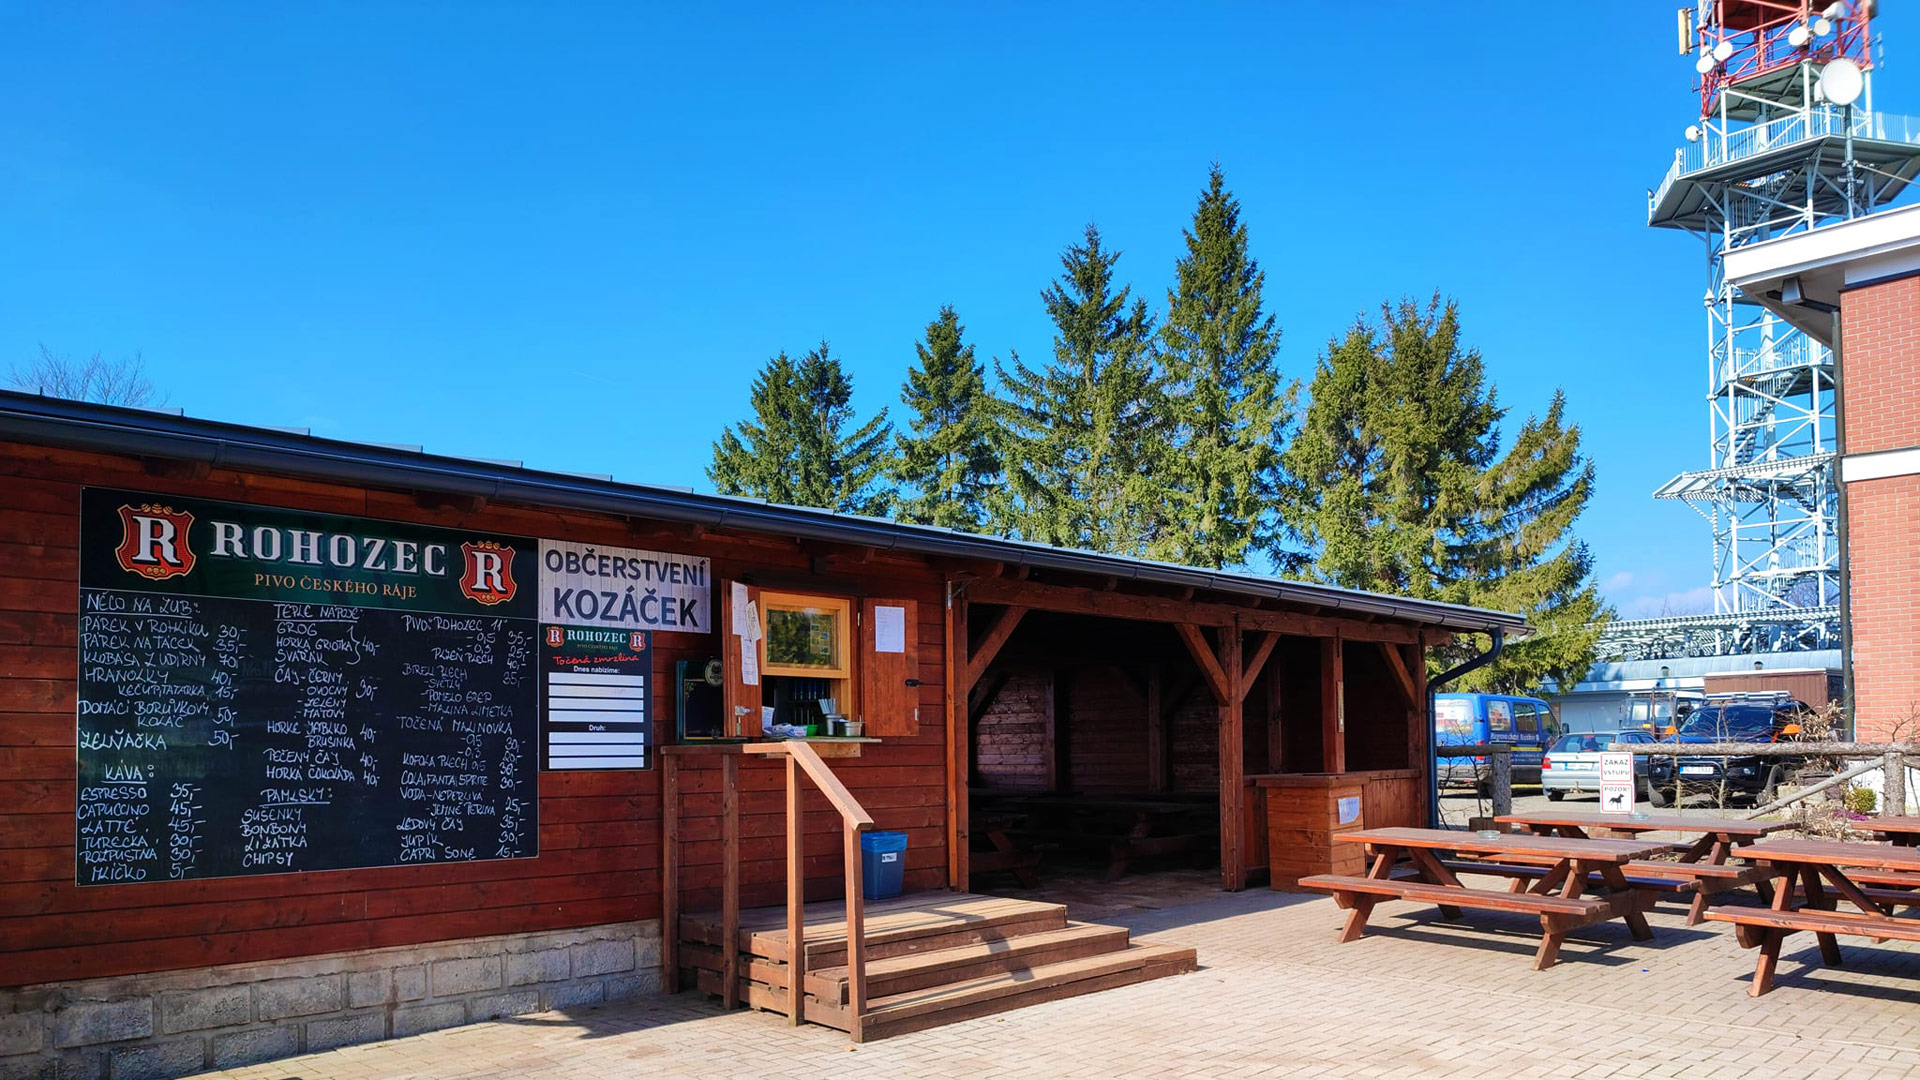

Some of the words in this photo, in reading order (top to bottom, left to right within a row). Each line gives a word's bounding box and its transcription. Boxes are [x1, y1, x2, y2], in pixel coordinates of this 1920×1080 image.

[132, 516, 184, 564] R
[210, 521, 446, 576] ROHOZEC
[472, 551, 506, 592] R
[545, 547, 706, 586] OBČERSTVENÍ
[254, 574, 296, 588] PIVO
[300, 576, 378, 594] ČESKÉHO
[382, 584, 417, 600] RÁJE
[86, 591, 125, 611] NĚCO
[133, 596, 152, 613] NA
[160, 597, 200, 615] ZUB:
[554, 584, 699, 627] KOZÁČEK
[81, 616, 131, 633] PÁREK
[135, 620, 144, 631] V
[218, 625, 247, 641] 30,-
[277, 622, 318, 636] GROG
[434, 616, 482, 632] ROHOZEC
[81, 633, 130, 649] PÁREK
[134, 637, 150, 649] NA
[213, 640, 247, 653] 35,-
[276, 637, 311, 650] HORKÁ
[315, 638, 352, 652] GRIOTKA
[362, 636, 380, 656] 40,-
[508, 631, 533, 646] 35,-
[566, 630, 626, 644] ROHOZEC
[84, 651, 140, 667] KLOBÁSA
[145, 652, 156, 667] Z
[219, 654, 244, 668] 70,-
[432, 647, 462, 662] PLZEŇ
[465, 652, 494, 664] PLECH
[507, 658, 526, 670] 40,-
[508, 645, 530, 662] 25,-
[85, 667, 168, 683] HRANOLKY
[211, 670, 237, 685] 40,-
[502, 672, 526, 688] 35,-
[216, 686, 239, 699] 15,-
[356, 680, 378, 700] 30,-
[466, 691, 492, 704] GREP
[79, 700, 130, 715] DOMÁCÍ
[213, 706, 238, 726] 50,-
[471, 705, 513, 718] LIMETKA
[138, 714, 184, 728] KOLÁČ
[396, 716, 444, 732] TOČENÁ
[452, 720, 512, 734] MALINOVKA
[80, 729, 166, 750] ZELŇAČKA
[208, 730, 240, 750] 50,-
[307, 722, 348, 736] JABLKO
[360, 723, 376, 742] 40,-
[306, 734, 356, 750] BRUSINKA
[505, 737, 526, 752] 30,-
[263, 748, 310, 762] PEČENÝ
[315, 749, 339, 765] ČAJ
[360, 752, 378, 771] 40,-
[402, 752, 436, 767] KOFOLA
[438, 755, 468, 770] PLECH
[266, 764, 302, 780] HORKÁ
[364, 770, 380, 787] 40,-
[500, 777, 522, 791] 30,-
[81, 787, 147, 800] ESPRESSO
[170, 783, 202, 800] 35,-
[78, 804, 150, 819] CAPUCCINO
[170, 800, 202, 817] 45,-
[506, 796, 530, 814] 25,-
[242, 806, 302, 824] SUŠENKY
[396, 816, 436, 830] LEDOVÝ
[442, 817, 464, 831] ČAJ
[500, 814, 526, 832] 35,-
[168, 816, 206, 833] 45,-
[240, 823, 306, 836] BONBONY
[170, 834, 202, 848] 30,-
[498, 831, 524, 844] 30,-
[170, 848, 203, 862] 30,-
[243, 852, 294, 868] CHIPSY
[400, 848, 436, 862] CAPRI
[496, 845, 522, 858] 15,-
[92, 862, 146, 881] MLÍČKO
[170, 863, 196, 880] 5,-
